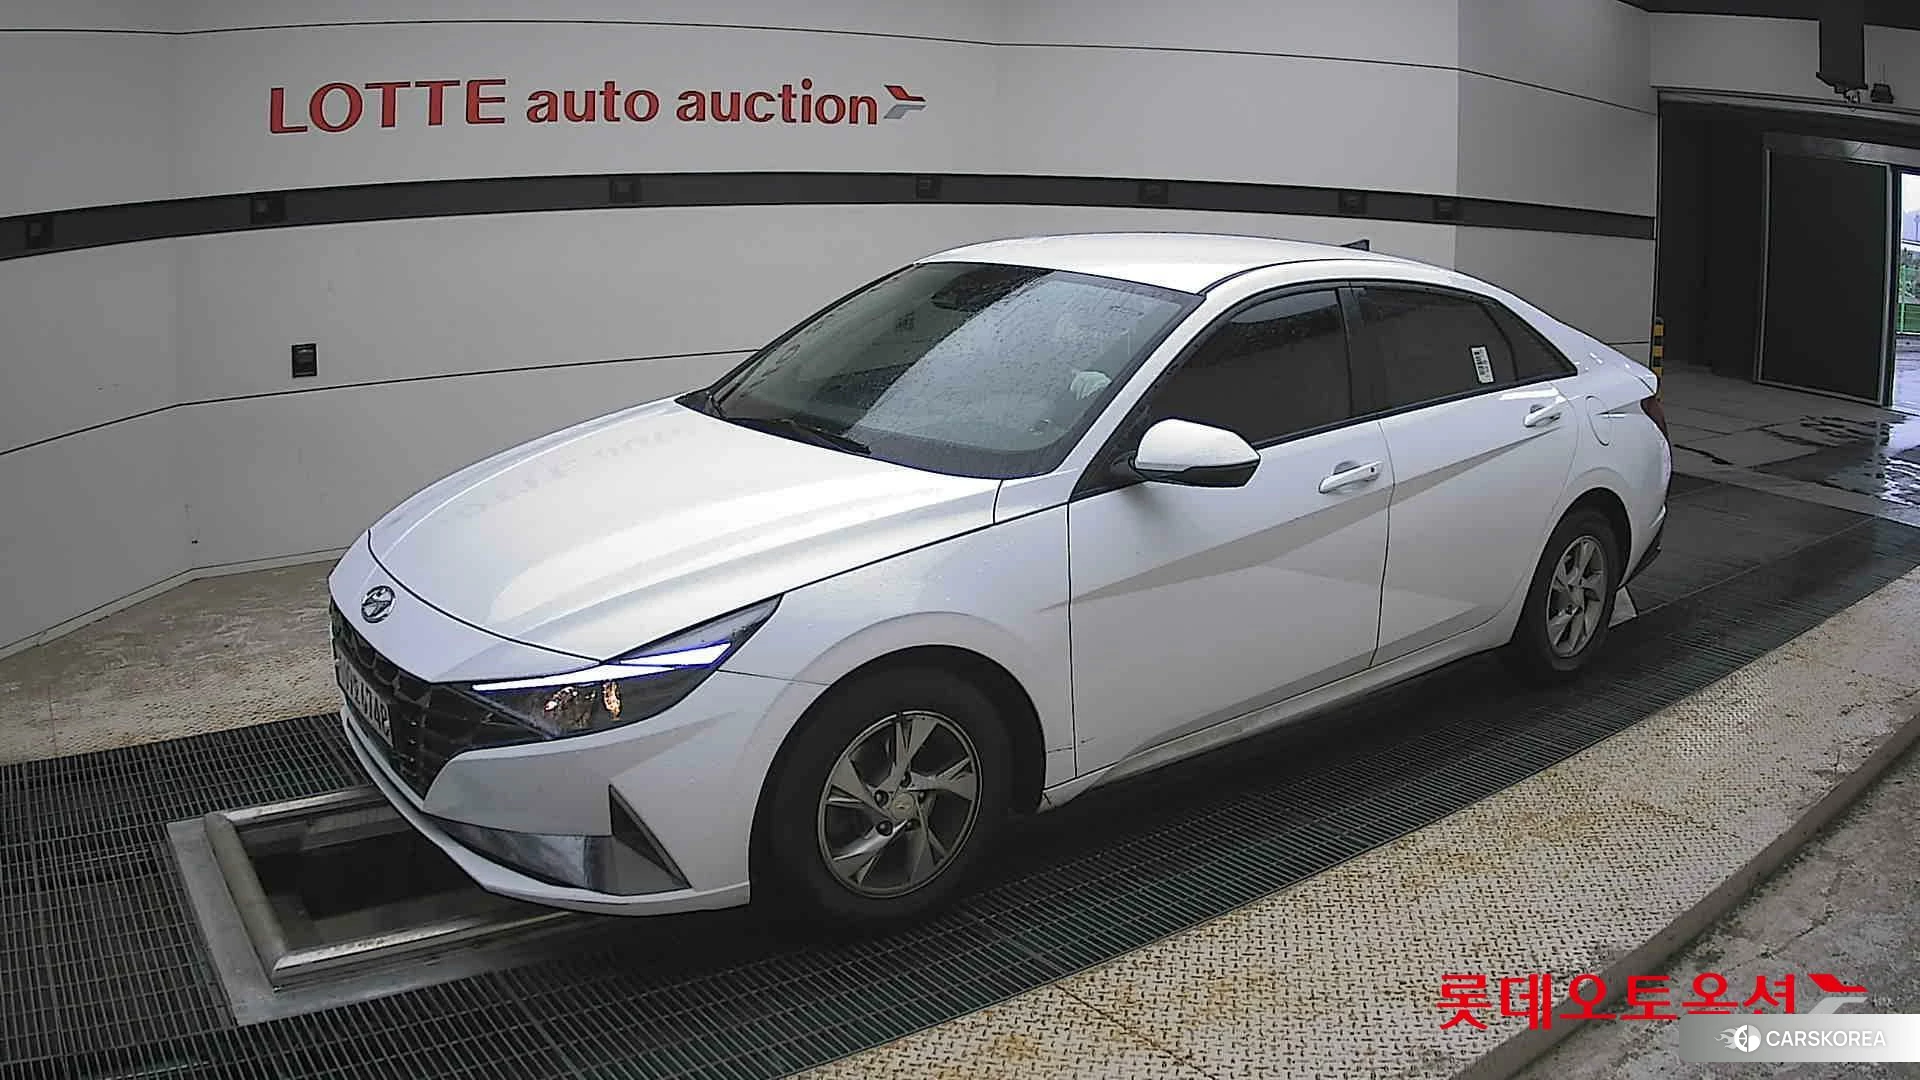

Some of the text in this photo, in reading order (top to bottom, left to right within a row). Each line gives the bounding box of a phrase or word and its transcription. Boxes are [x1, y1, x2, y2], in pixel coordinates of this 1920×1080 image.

[270, 78, 878, 133] LOTTE auto auction
